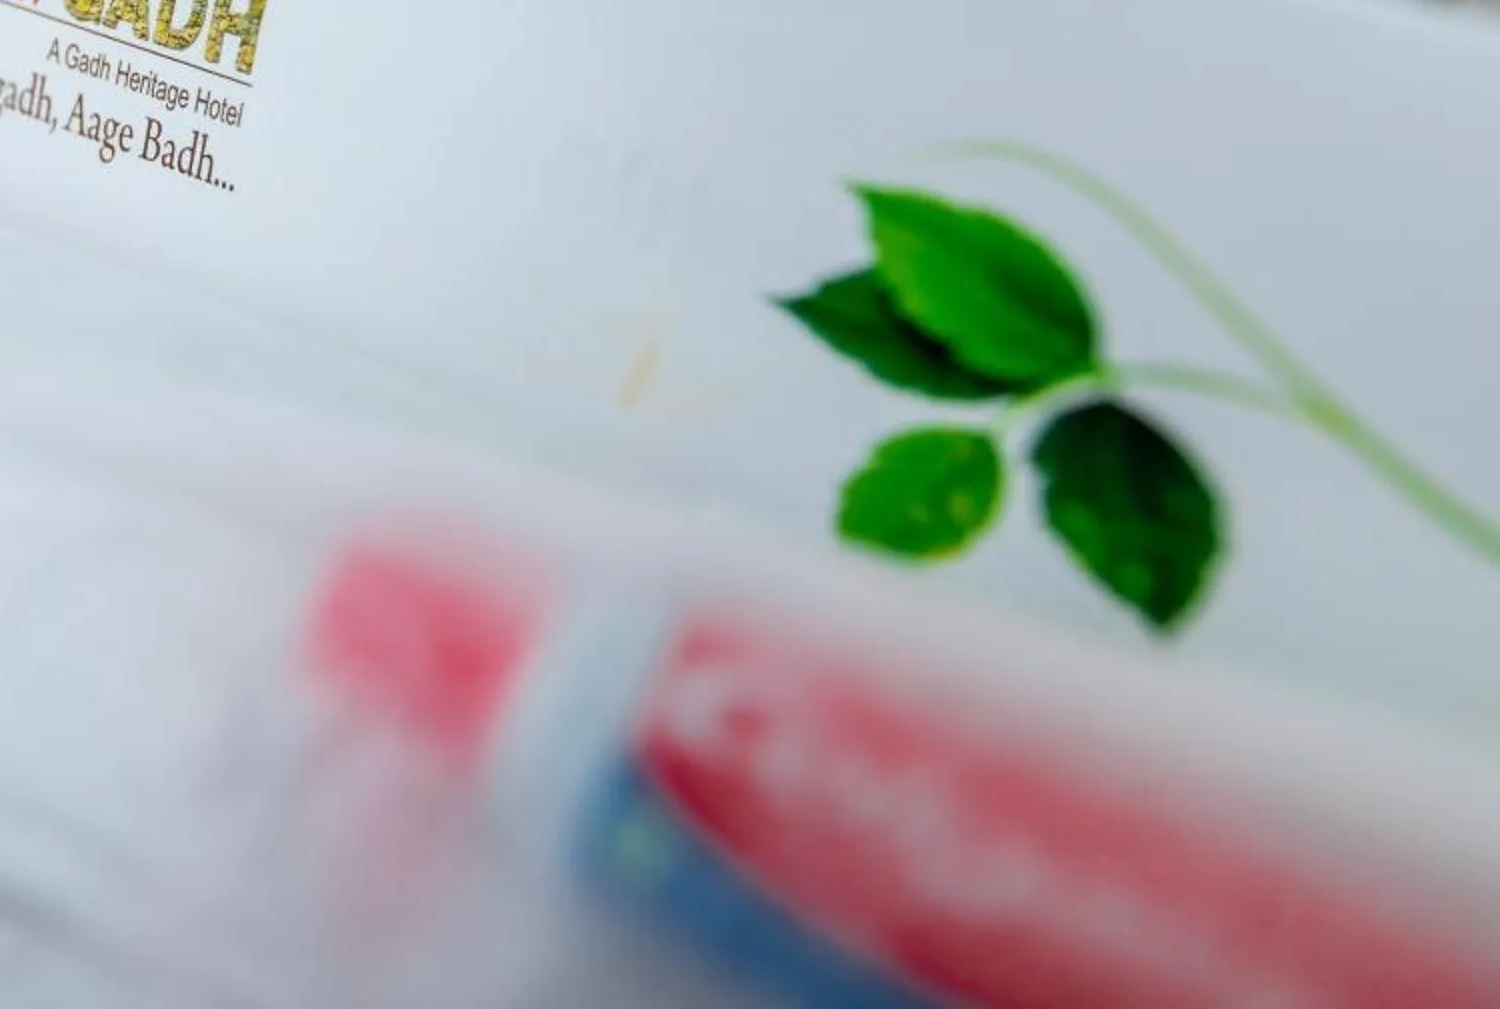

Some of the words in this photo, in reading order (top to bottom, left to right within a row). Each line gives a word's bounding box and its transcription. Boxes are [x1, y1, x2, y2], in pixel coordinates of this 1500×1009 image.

[46, 37, 61, 64] A
[64, 42, 111, 80] Gadh
[115, 58, 190, 112] Heritage
[194, 86, 246, 129] Hotel
[64, 92, 135, 164] Aage
[138, 115, 236, 192] Badh...
